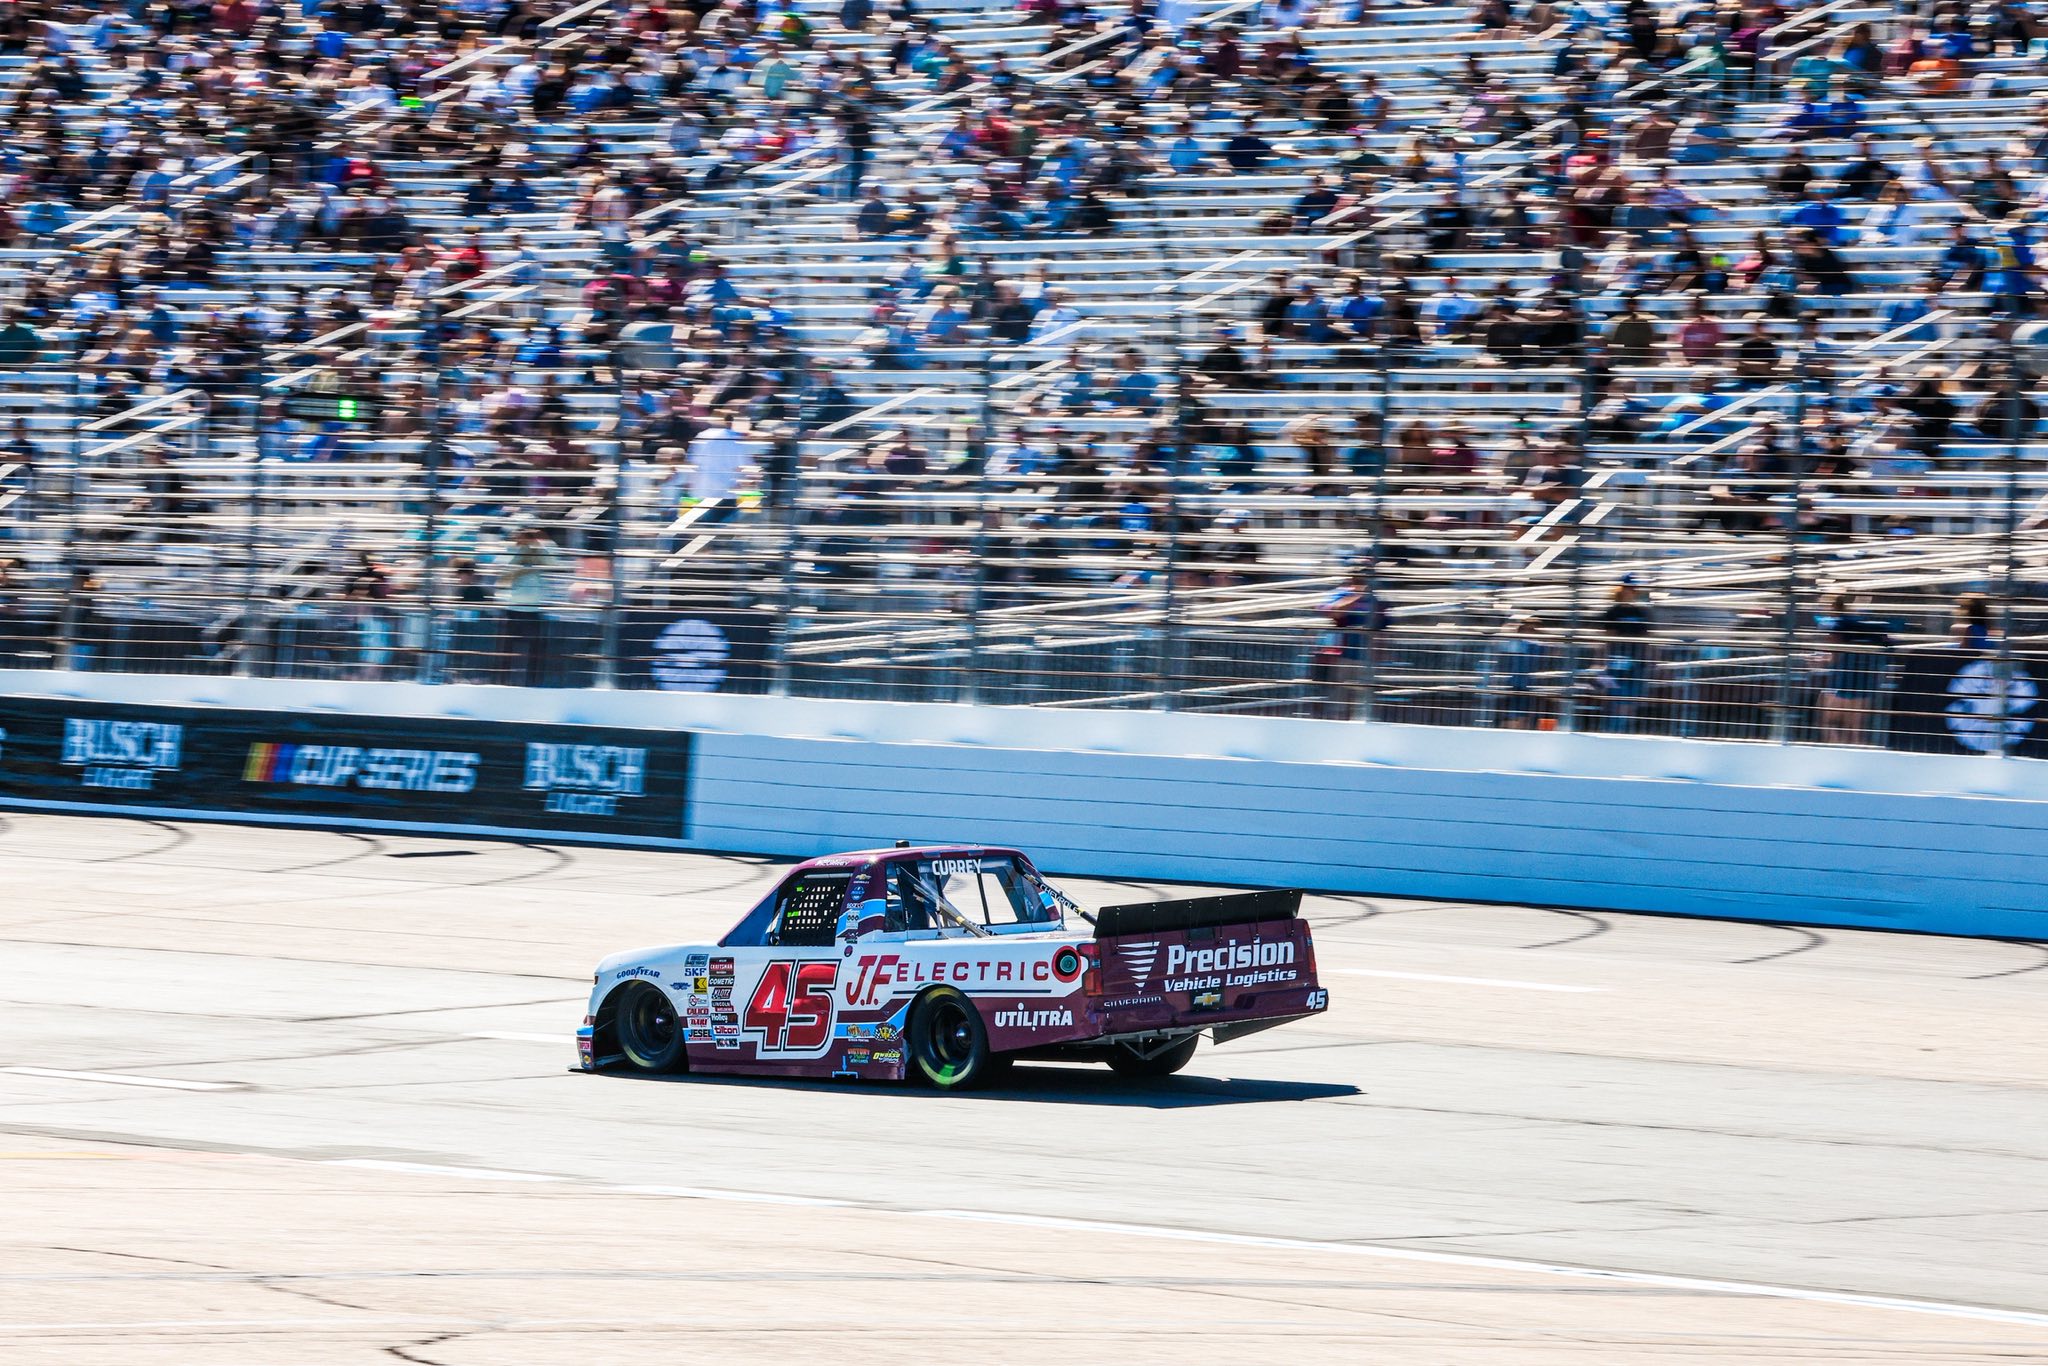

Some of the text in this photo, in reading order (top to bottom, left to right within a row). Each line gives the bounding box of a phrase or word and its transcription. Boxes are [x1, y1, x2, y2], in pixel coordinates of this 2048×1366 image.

[60, 718, 184, 771] BUSCH
[291, 744, 483, 793] CUP SERIES
[522, 742, 648, 797] BUSCH
[931, 859, 982, 876] CURREY
[1166, 936, 1295, 976] Precision
[616, 966, 661, 980] GOODYEAR
[684, 968, 707, 977] SKF
[896, 961, 1049, 982] ELECTRIC
[1163, 968, 1297, 993] Vehicle Logistics
[743, 959, 842, 1053] 45
[1306, 991, 1327, 1010] 45
[711, 1014, 728, 1023] Holley
[688, 1029, 712, 1037] JESEL
[714, 1026, 738, 1034] tilton
